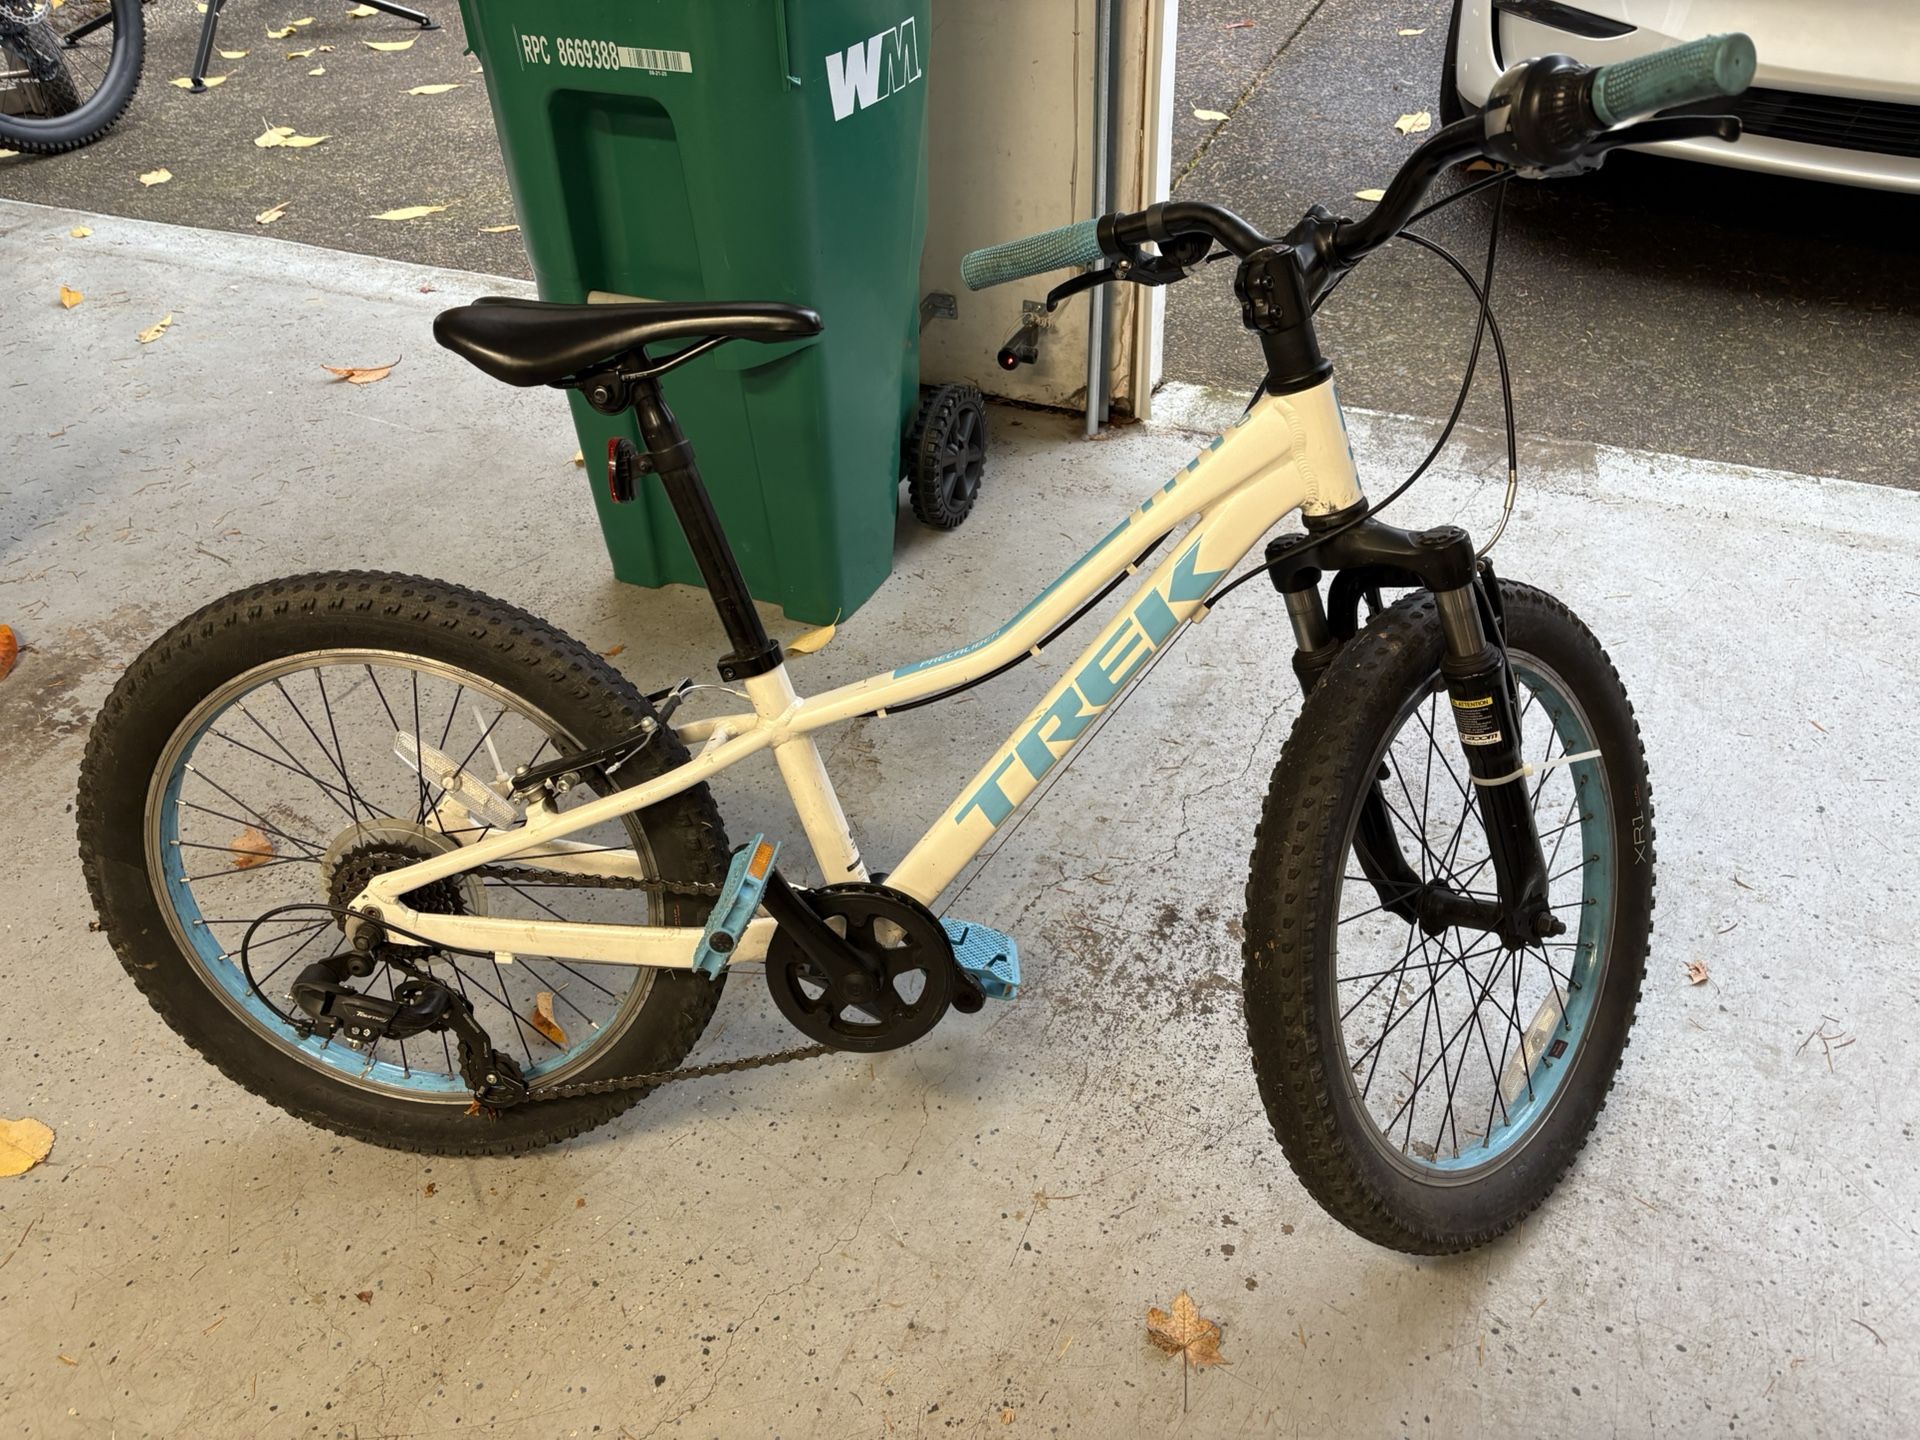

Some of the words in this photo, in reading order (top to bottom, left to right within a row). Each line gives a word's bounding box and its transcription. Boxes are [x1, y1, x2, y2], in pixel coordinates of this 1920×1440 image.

[521, 34, 551, 65] RPC
[556, 37, 620, 71] 8669388
[825, 16, 922, 121] WM
[954, 533, 1229, 829] TREK
[1458, 699, 1489, 708] ATTENTION
[1632, 809, 1646, 865] XR1
